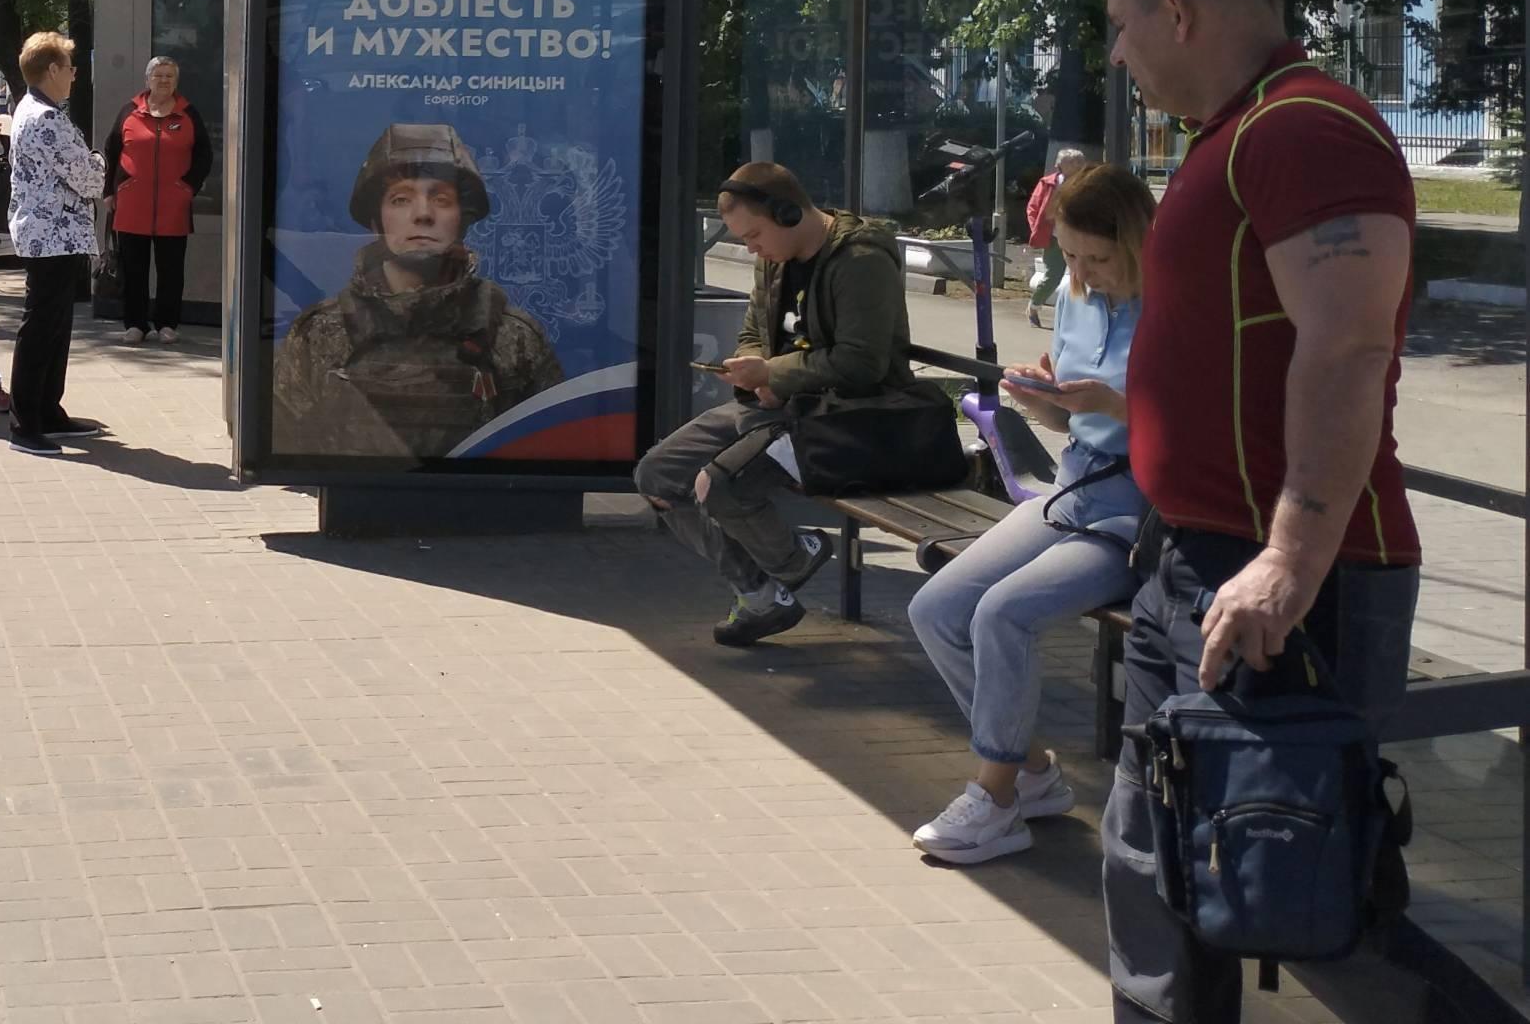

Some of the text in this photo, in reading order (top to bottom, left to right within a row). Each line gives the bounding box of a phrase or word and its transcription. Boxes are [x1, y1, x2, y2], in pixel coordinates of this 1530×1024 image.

[306, 27, 612, 59] И МУЖЕСТВО!
[348, 74, 565, 93] АЛЕКСАНДР СИНИЦЫН
[424, 93, 489, 106] ЕФРЕЙТОР
